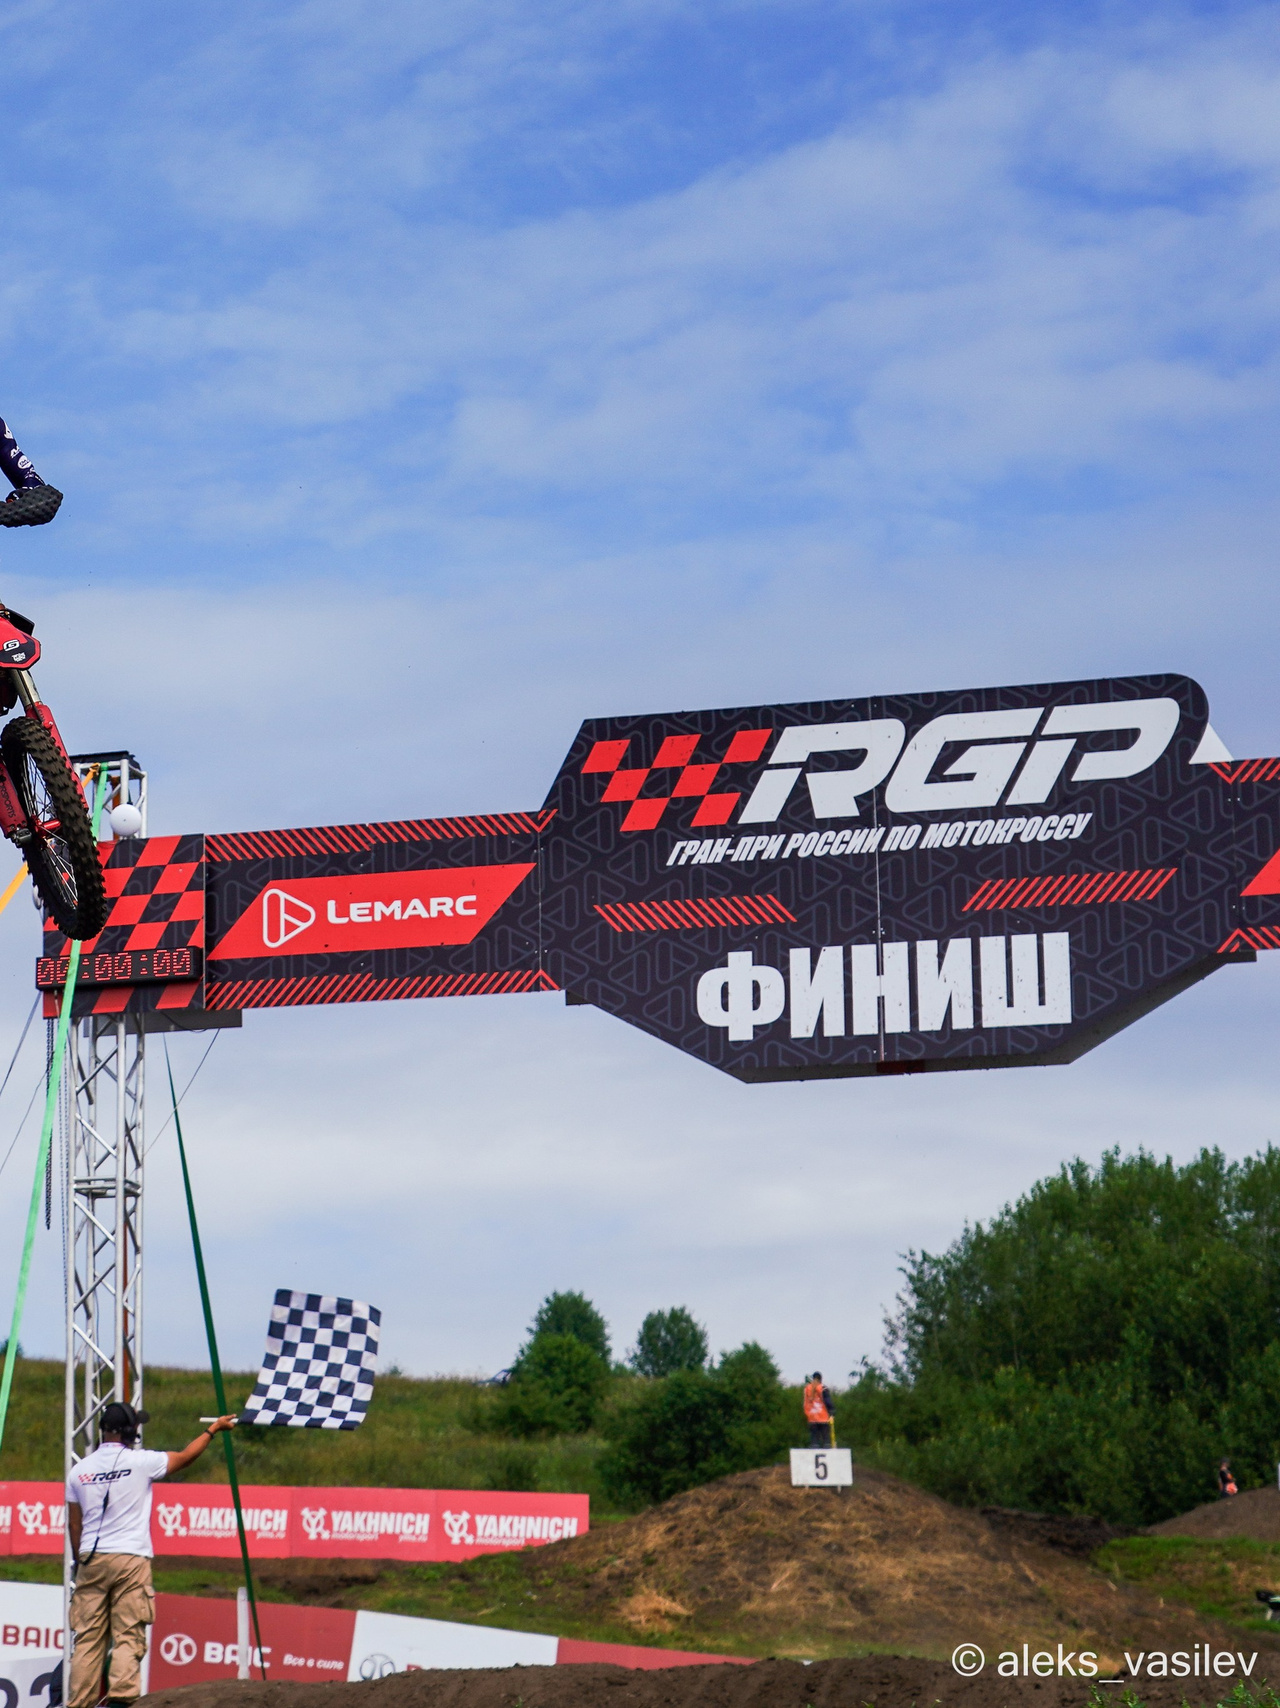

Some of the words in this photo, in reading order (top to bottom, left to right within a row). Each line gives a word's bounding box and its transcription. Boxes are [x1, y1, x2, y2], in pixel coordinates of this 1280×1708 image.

[737, 698, 1180, 824] RGP
[666, 834, 785, 866] ГРАН-ПРИ
[781, 826, 885, 859] РОССИИ
[881, 824, 923, 852] ПО
[919, 813, 1093, 850] МОТОКРОССУ
[696, 932, 1073, 1042] ФИНИШ
[814, 1453, 828, 1481] 5
[187, 1507, 288, 1531] YAKHNICH
[331, 1511, 430, 1535] YAKHNICH
[475, 1514, 578, 1539] YAKHNICH
[2, 1624, 64, 1649] BAIC
